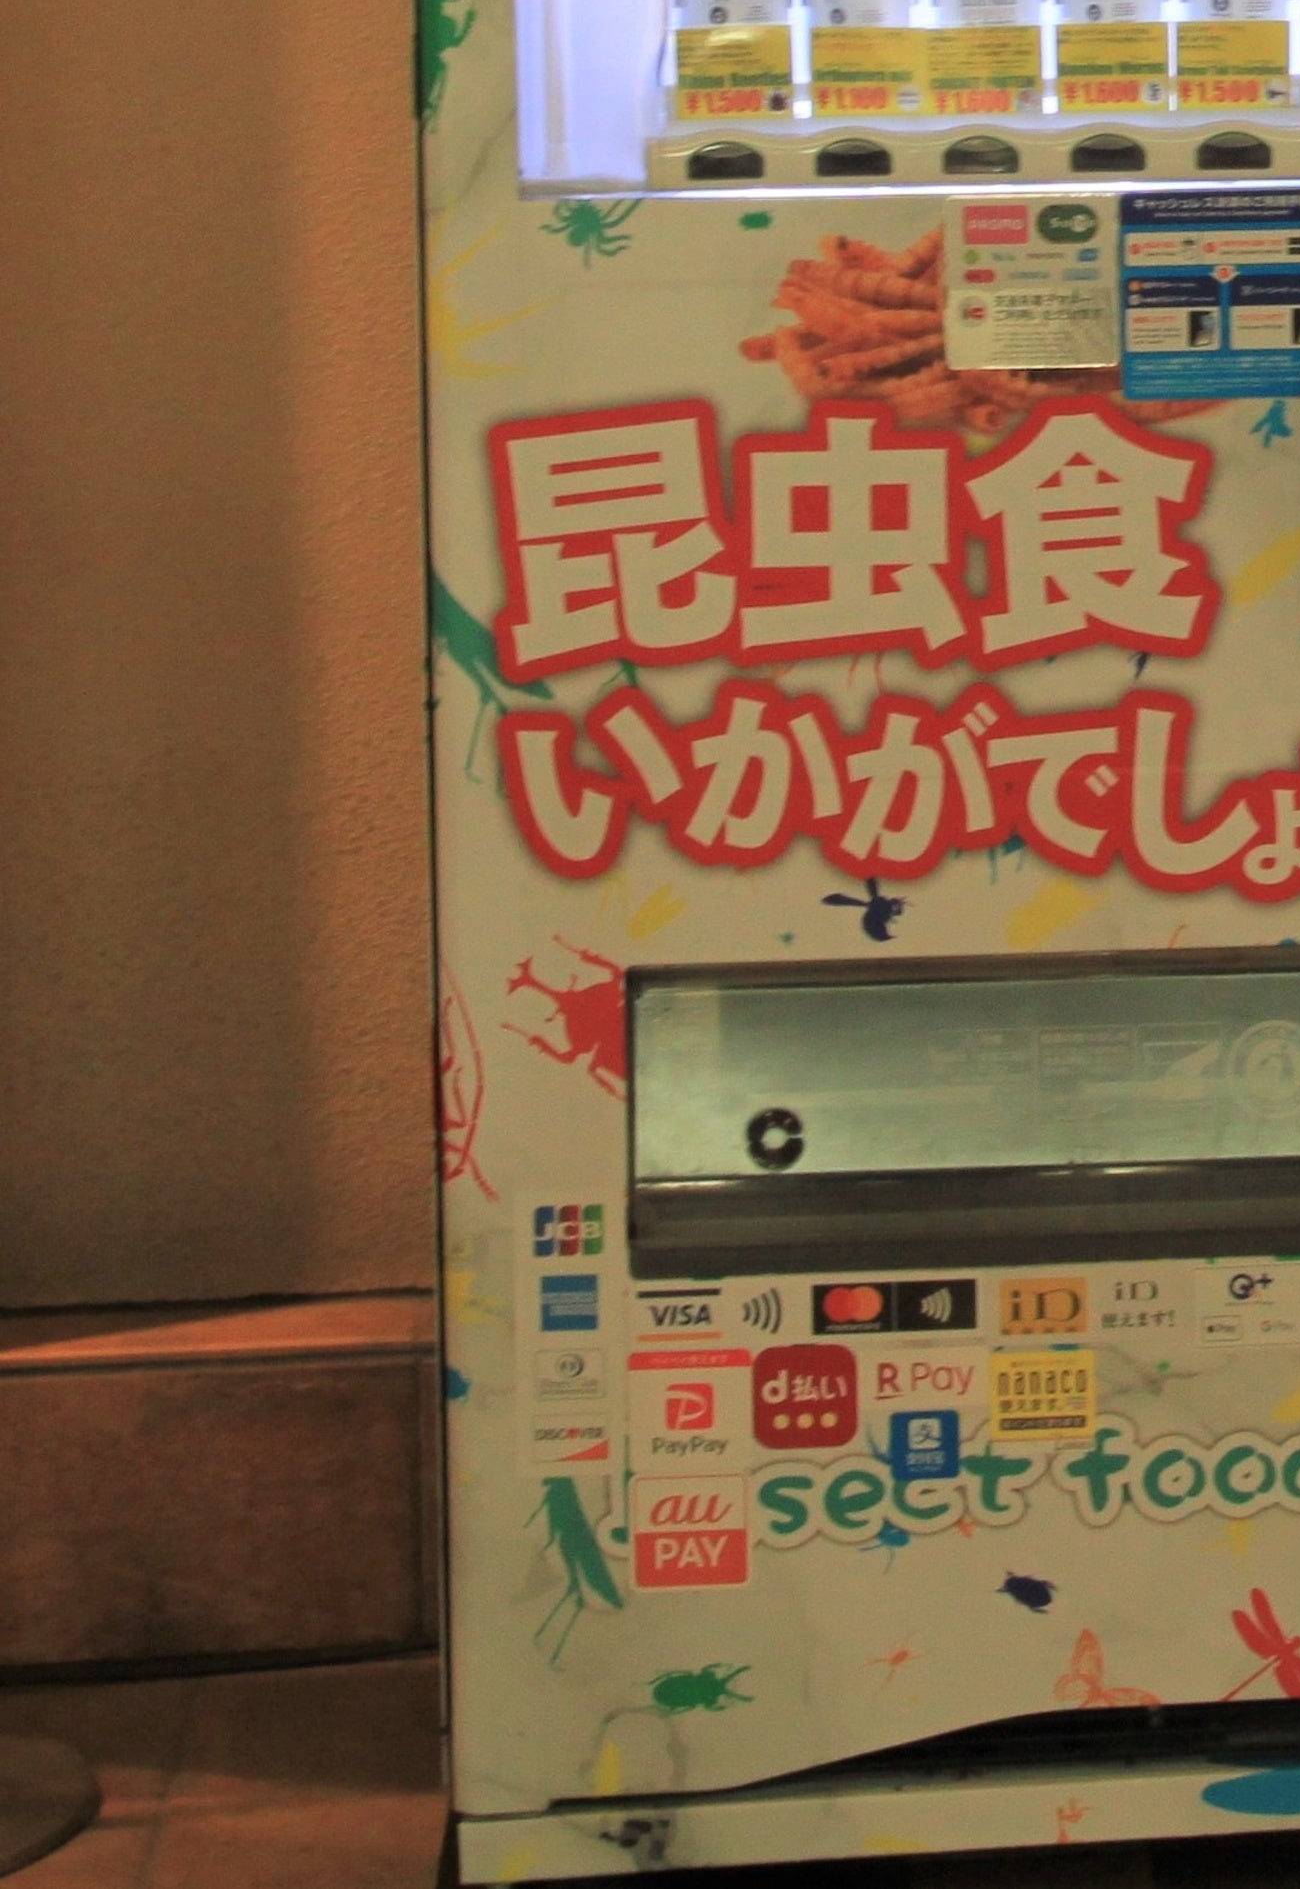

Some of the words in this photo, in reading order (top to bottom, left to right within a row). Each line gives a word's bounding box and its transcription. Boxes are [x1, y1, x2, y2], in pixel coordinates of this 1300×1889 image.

[505, 411, 1202, 667] 昆虫食
[648, 1302, 713, 1327] VISA
[761, 1370, 849, 1403] d払い
[911, 1361, 976, 1395] Pay
[997, 1366, 1090, 1397] nanaco
[651, 1434, 728, 1457] PayPay
[649, 1493, 733, 1525] au
[653, 1537, 729, 1570] PAY
